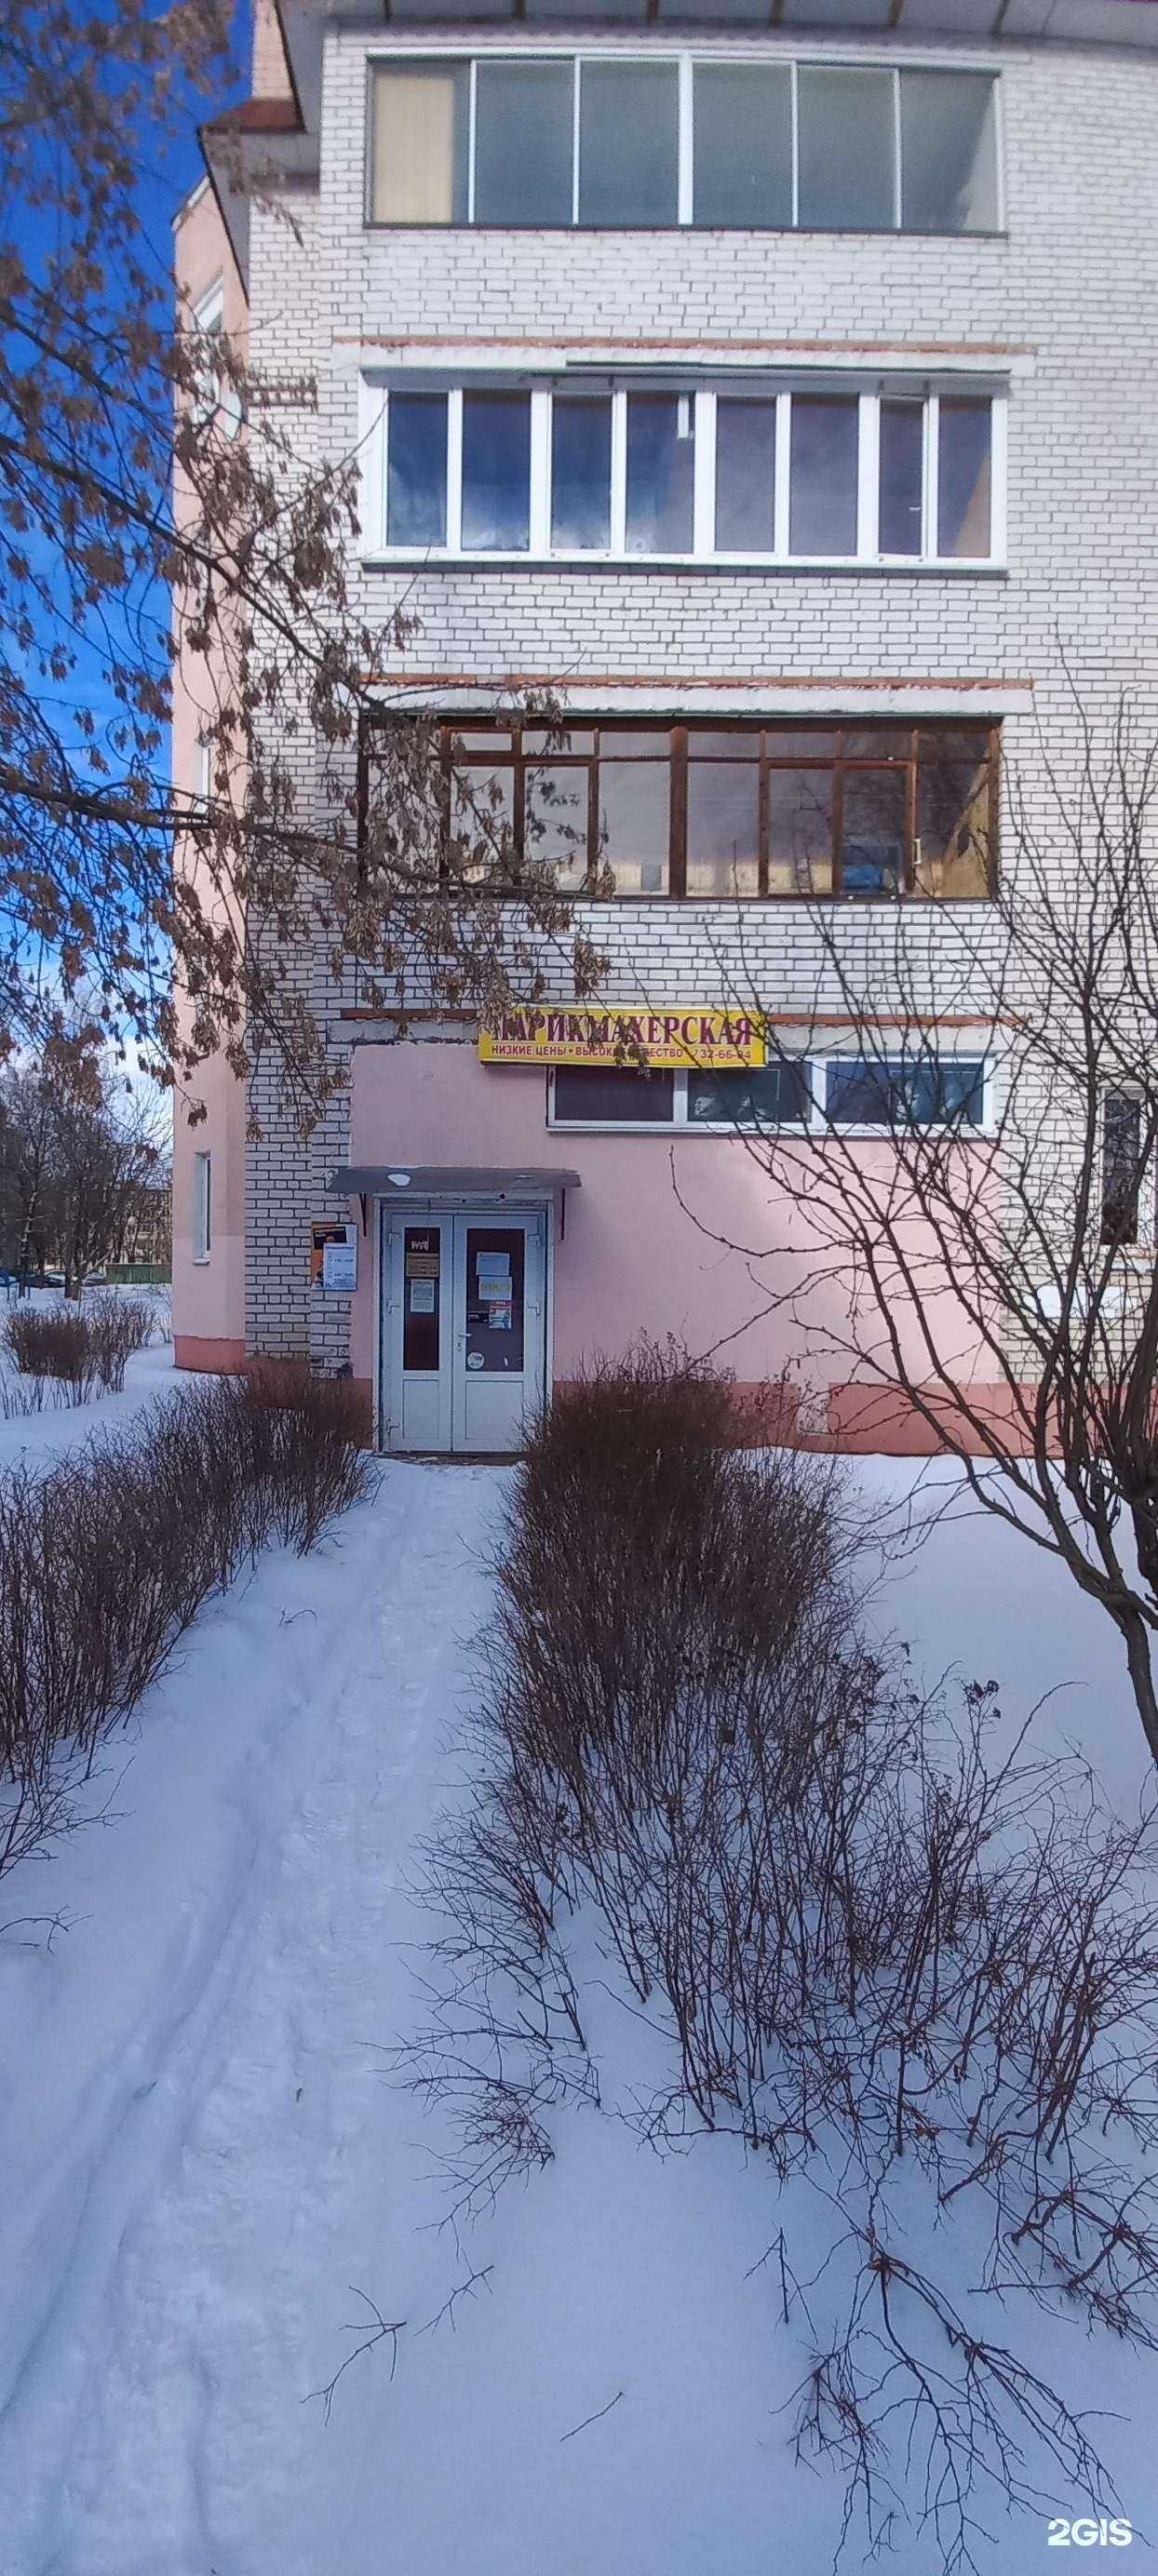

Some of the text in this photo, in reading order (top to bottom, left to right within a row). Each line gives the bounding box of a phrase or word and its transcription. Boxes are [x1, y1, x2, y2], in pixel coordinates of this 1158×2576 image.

[491, 1045, 532, 1055] НИЗКИЕ
[535, 1046, 566, 1057] ЦЕНЫ
[575, 1047, 626, 1057] ВЫСОК
[629, 1048, 683, 1058] ЕСТВО
